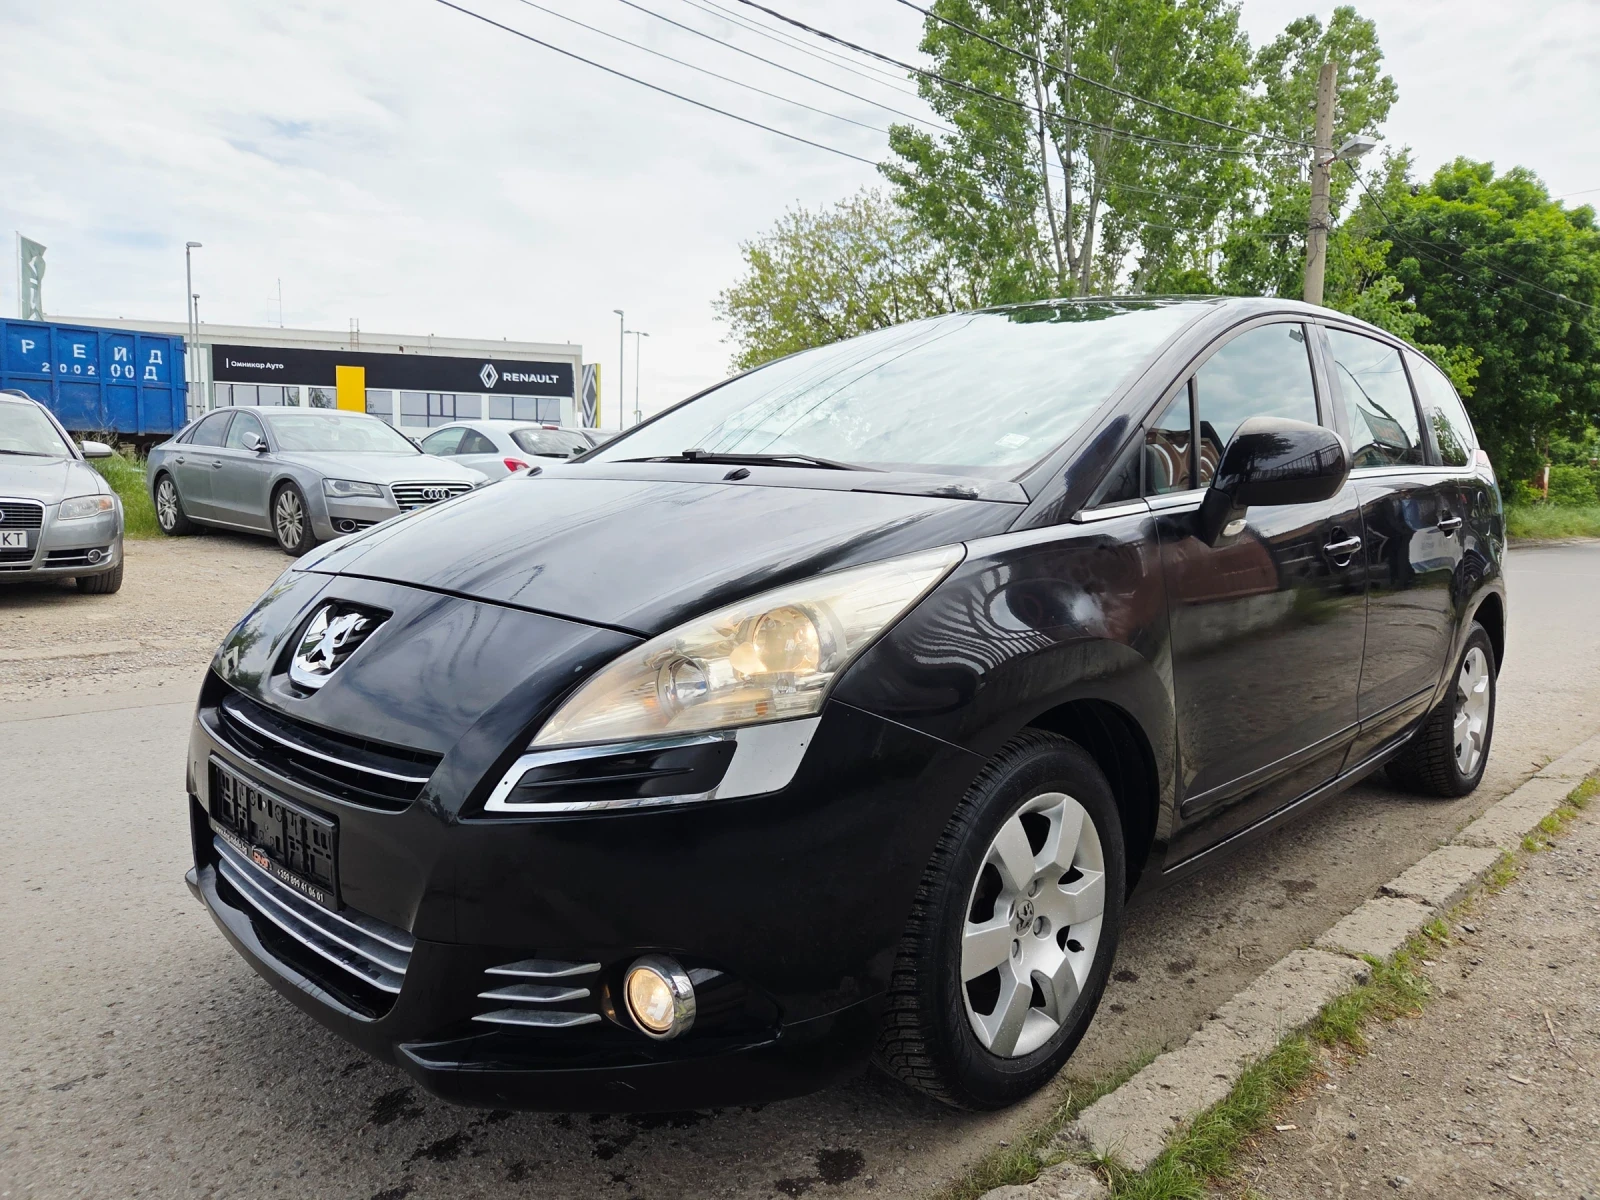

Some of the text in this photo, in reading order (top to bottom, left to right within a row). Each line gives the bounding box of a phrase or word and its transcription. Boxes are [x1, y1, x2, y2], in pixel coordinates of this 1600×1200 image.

[21, 338, 163, 365] РЕЙД
[41, 362, 96, 376] 2002
[231, 360, 284, 370] Омникар Ауто
[502, 372, 559, 384] RENAULT
[316, 891, 324, 903] 01
